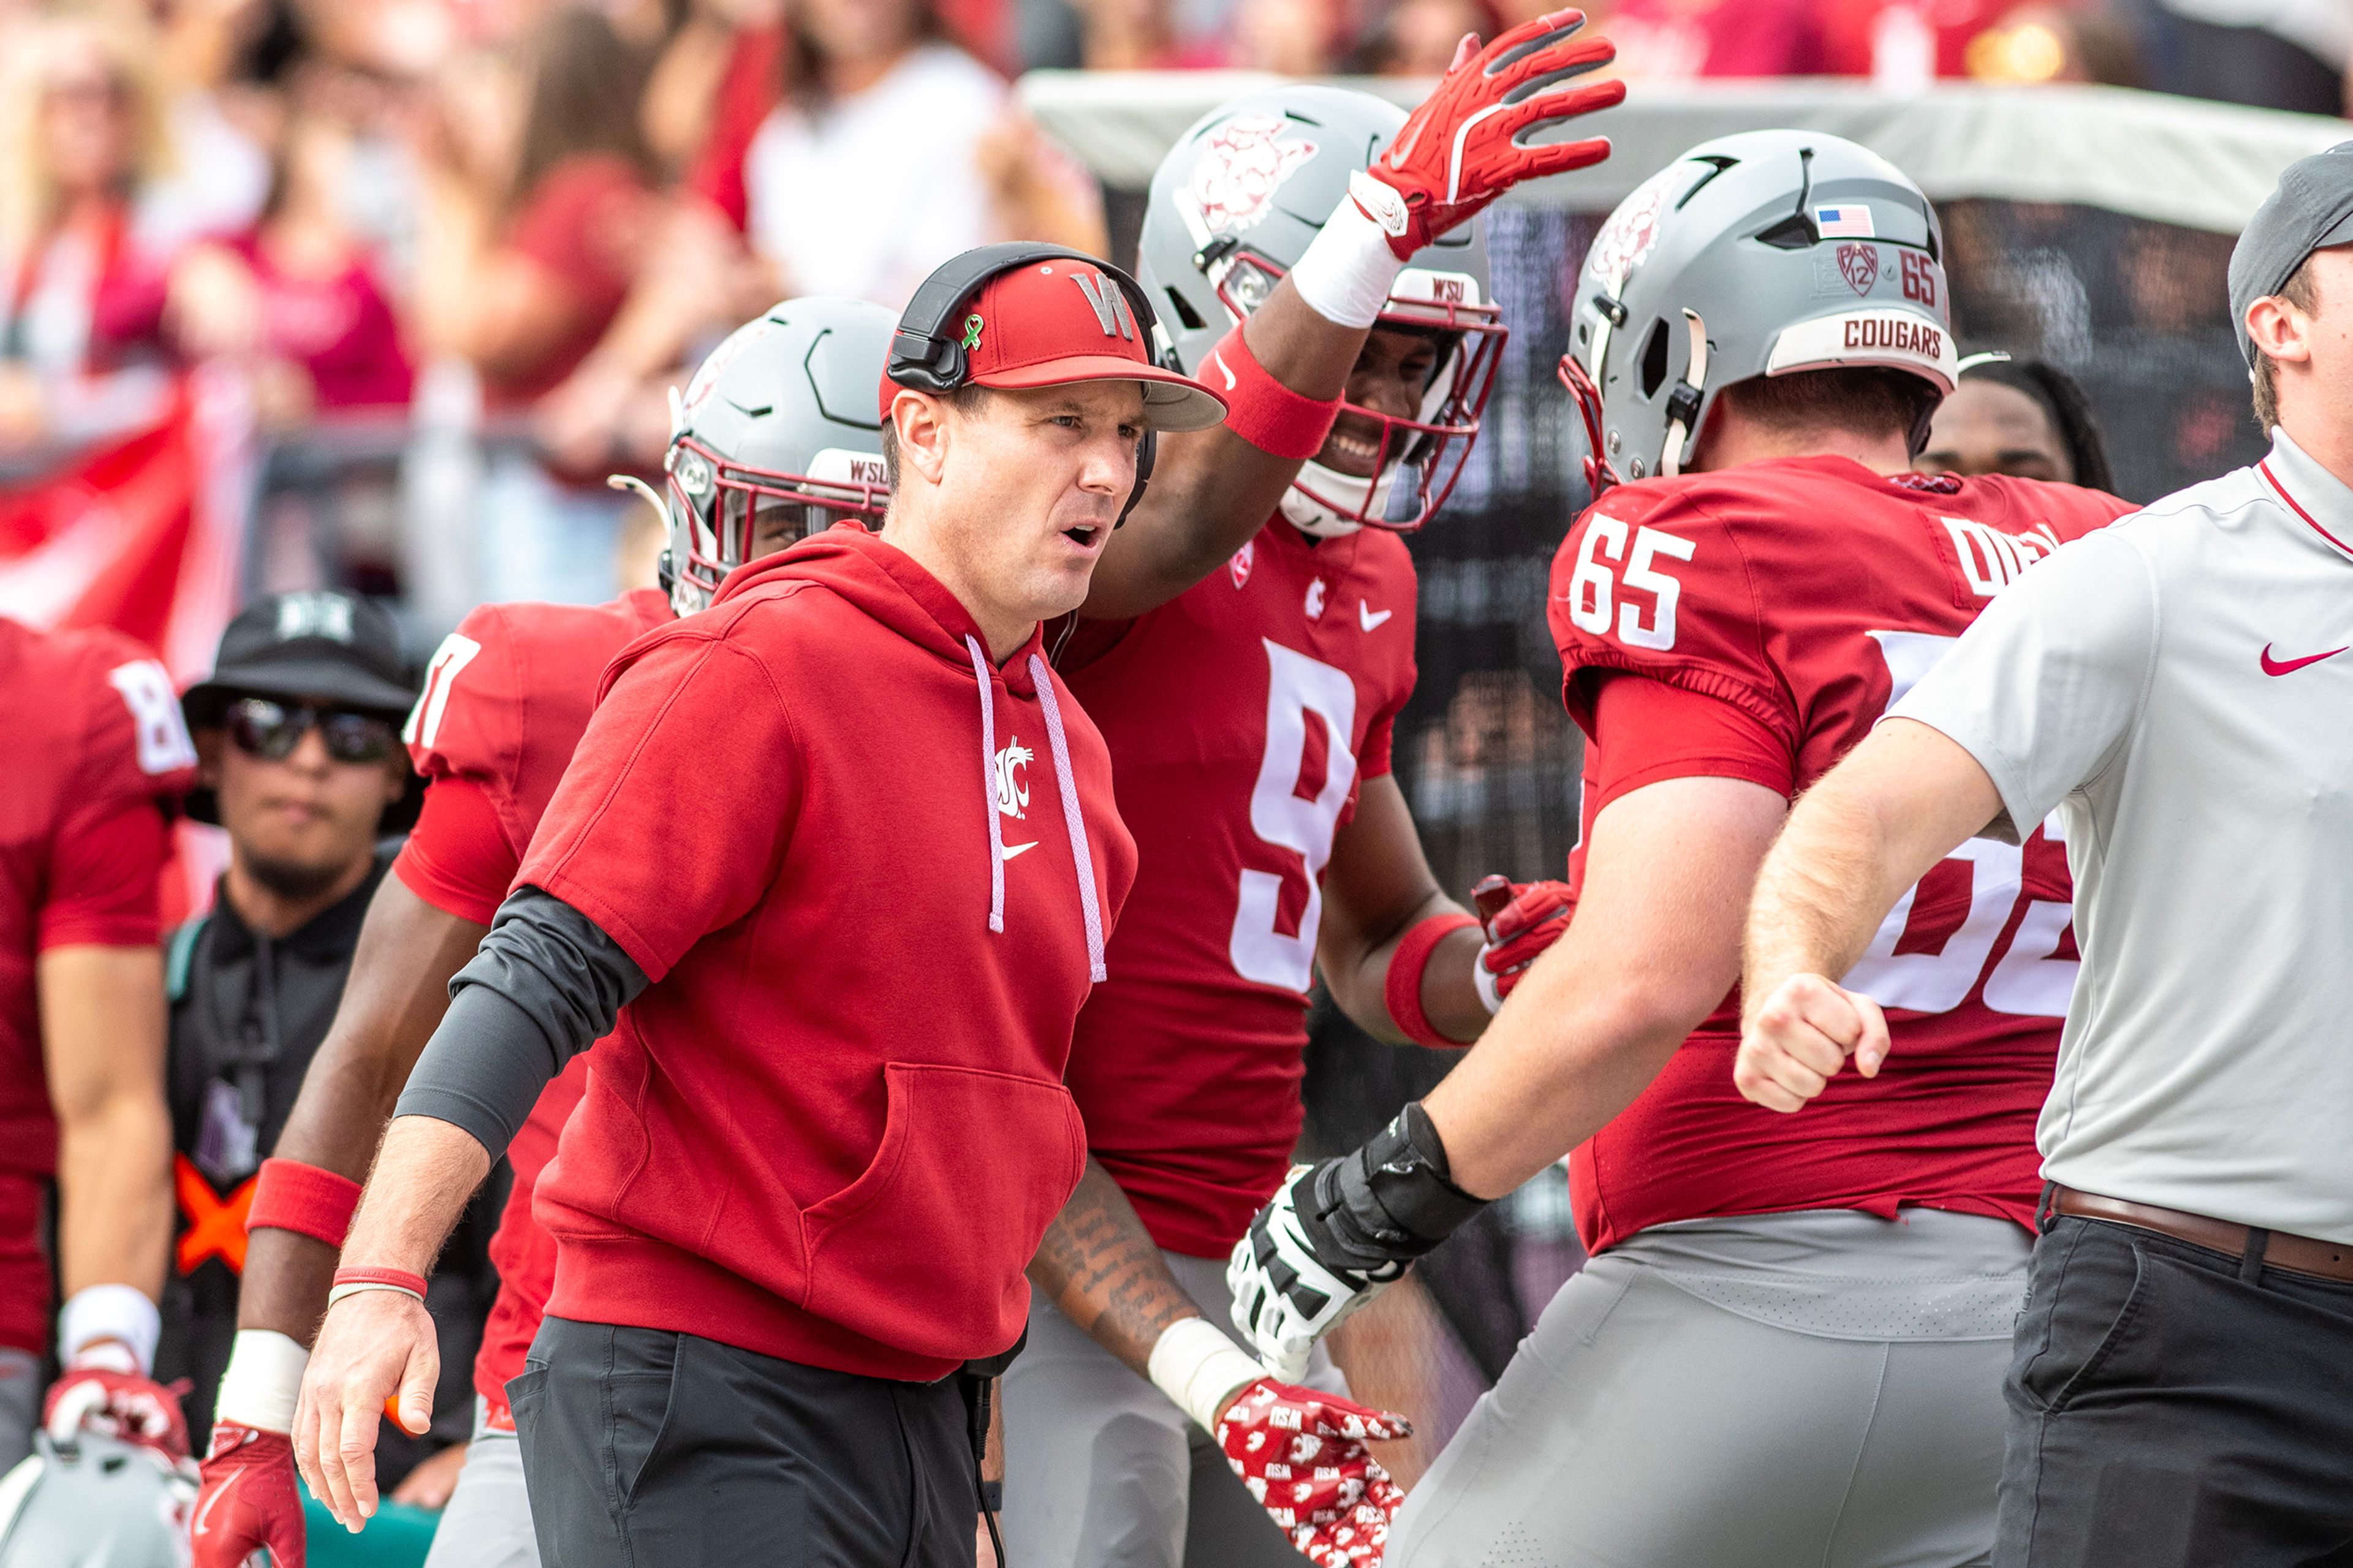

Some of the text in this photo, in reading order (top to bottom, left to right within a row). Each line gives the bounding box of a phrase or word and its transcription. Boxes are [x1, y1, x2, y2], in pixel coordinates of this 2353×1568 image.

[1433, 277, 1464, 301] WSU
[1851, 267, 1871, 285] 12
[1899, 249, 1935, 308] 65
[1069, 273, 1134, 341] W
[1844, 319, 1941, 360] COUGARS
[1569, 512, 1697, 652] 65
[1230, 635, 1358, 993] 9
[1268, 1406, 1302, 1432] WSU
[1265, 1463, 1292, 1480] WSU
[1314, 1466, 1341, 1482] WSU
